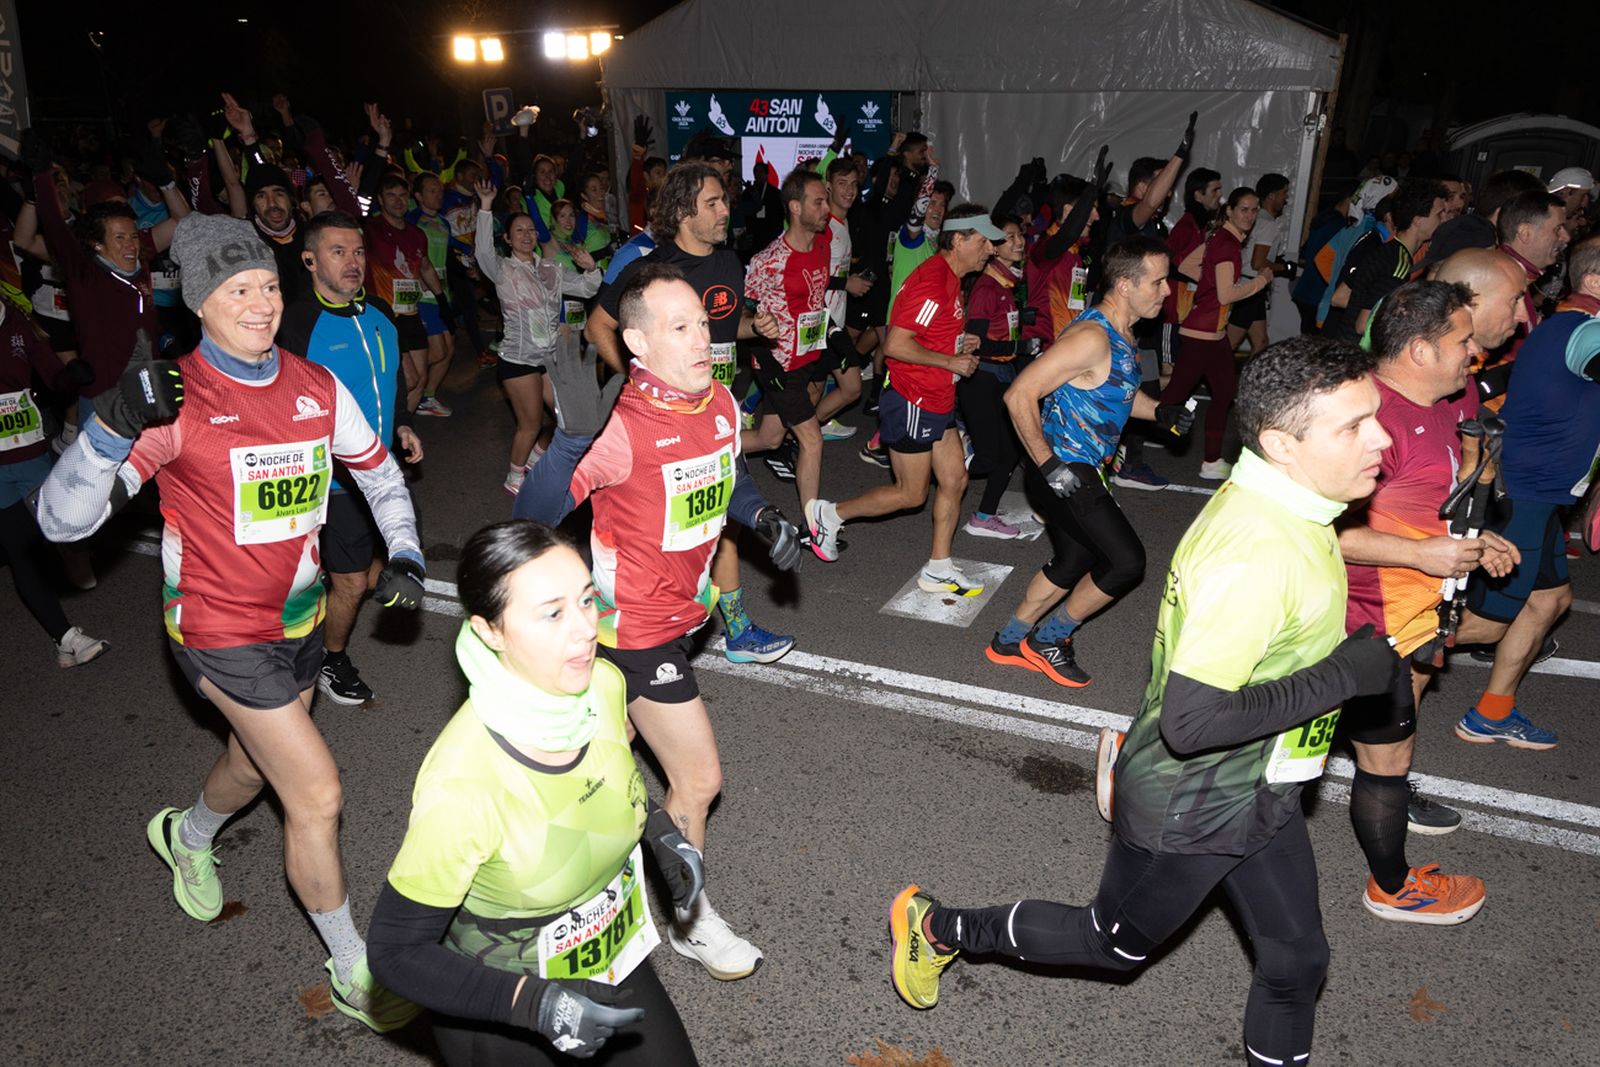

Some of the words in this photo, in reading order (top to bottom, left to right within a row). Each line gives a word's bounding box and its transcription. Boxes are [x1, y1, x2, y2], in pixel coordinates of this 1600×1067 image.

[491, 95, 509, 130] P
[749, 98, 768, 116] 43
[768, 98, 803, 115] SAN
[745, 115, 801, 133] ANTÓN
[259, 454, 291, 467] NOCHE
[293, 453, 305, 463] DE
[248, 469, 270, 481] SAN
[685, 466, 708, 480] NOCHE
[708, 463, 719, 473] DE
[258, 474, 321, 510] 6822
[676, 483, 692, 495] SAN
[686, 481, 725, 518] 1387
[570, 904, 607, 935] NOCHE
[555, 933, 582, 954] SAN
[563, 896, 635, 976] 13781
[909, 930, 920, 962] HOKA
